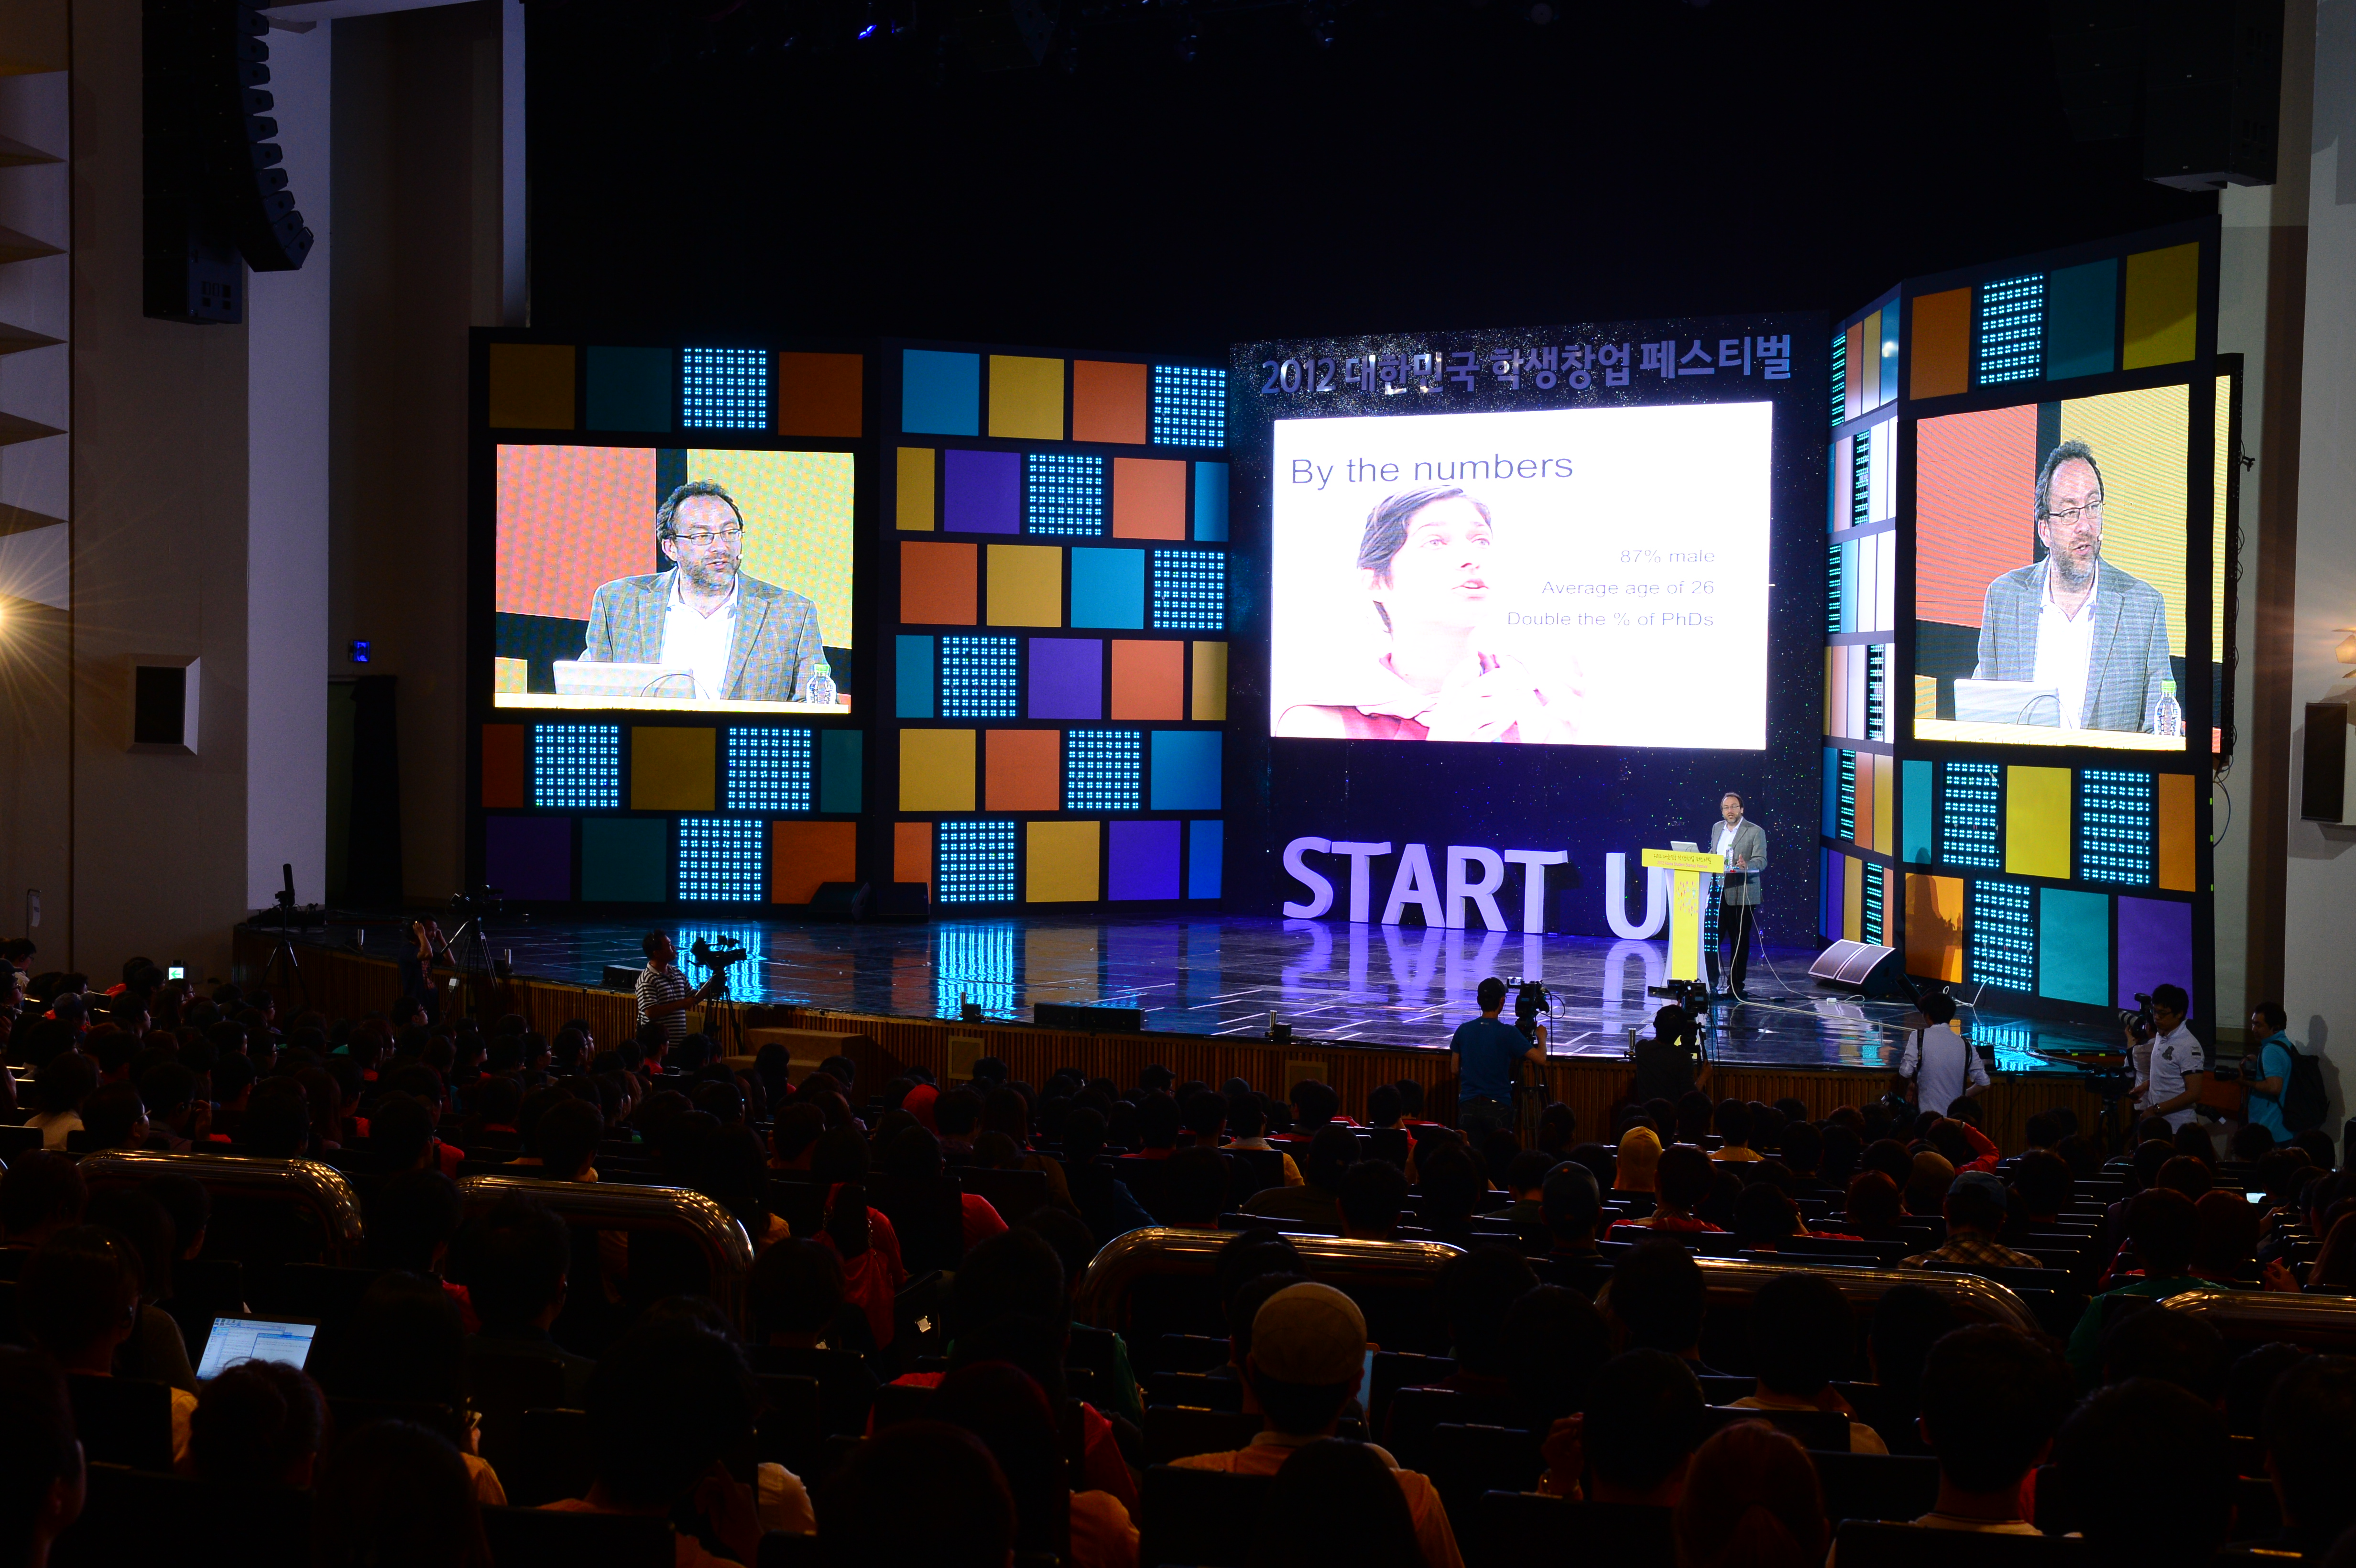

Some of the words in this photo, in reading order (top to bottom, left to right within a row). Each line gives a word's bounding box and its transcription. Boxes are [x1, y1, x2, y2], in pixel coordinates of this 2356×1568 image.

[1261, 359, 1336, 395] 2012
[1345, 350, 1481, 395] 대한민국
[1489, 342, 1630, 390] 학생창업
[1639, 334, 1791, 380] 페스티벌
[1292, 459, 1334, 490] By
[1346, 457, 1399, 482] the
[1415, 453, 1573, 480] numbers
[1620, 549, 1661, 563] 87%
[1669, 549, 1715, 563] male
[1542, 581, 1618, 598] Average
[1625, 584, 1659, 598] age
[1667, 581, 1686, 594] of
[1691, 581, 1714, 594] 26
[1508, 612, 1571, 625] Double
[1578, 612, 1605, 625] the
[1614, 612, 1630, 626] %
[1637, 612, 1655, 626] of
[1662, 612, 1714, 626] PhDs
[1283, 837, 1568, 935] START
[1605, 852, 1668, 940] U
